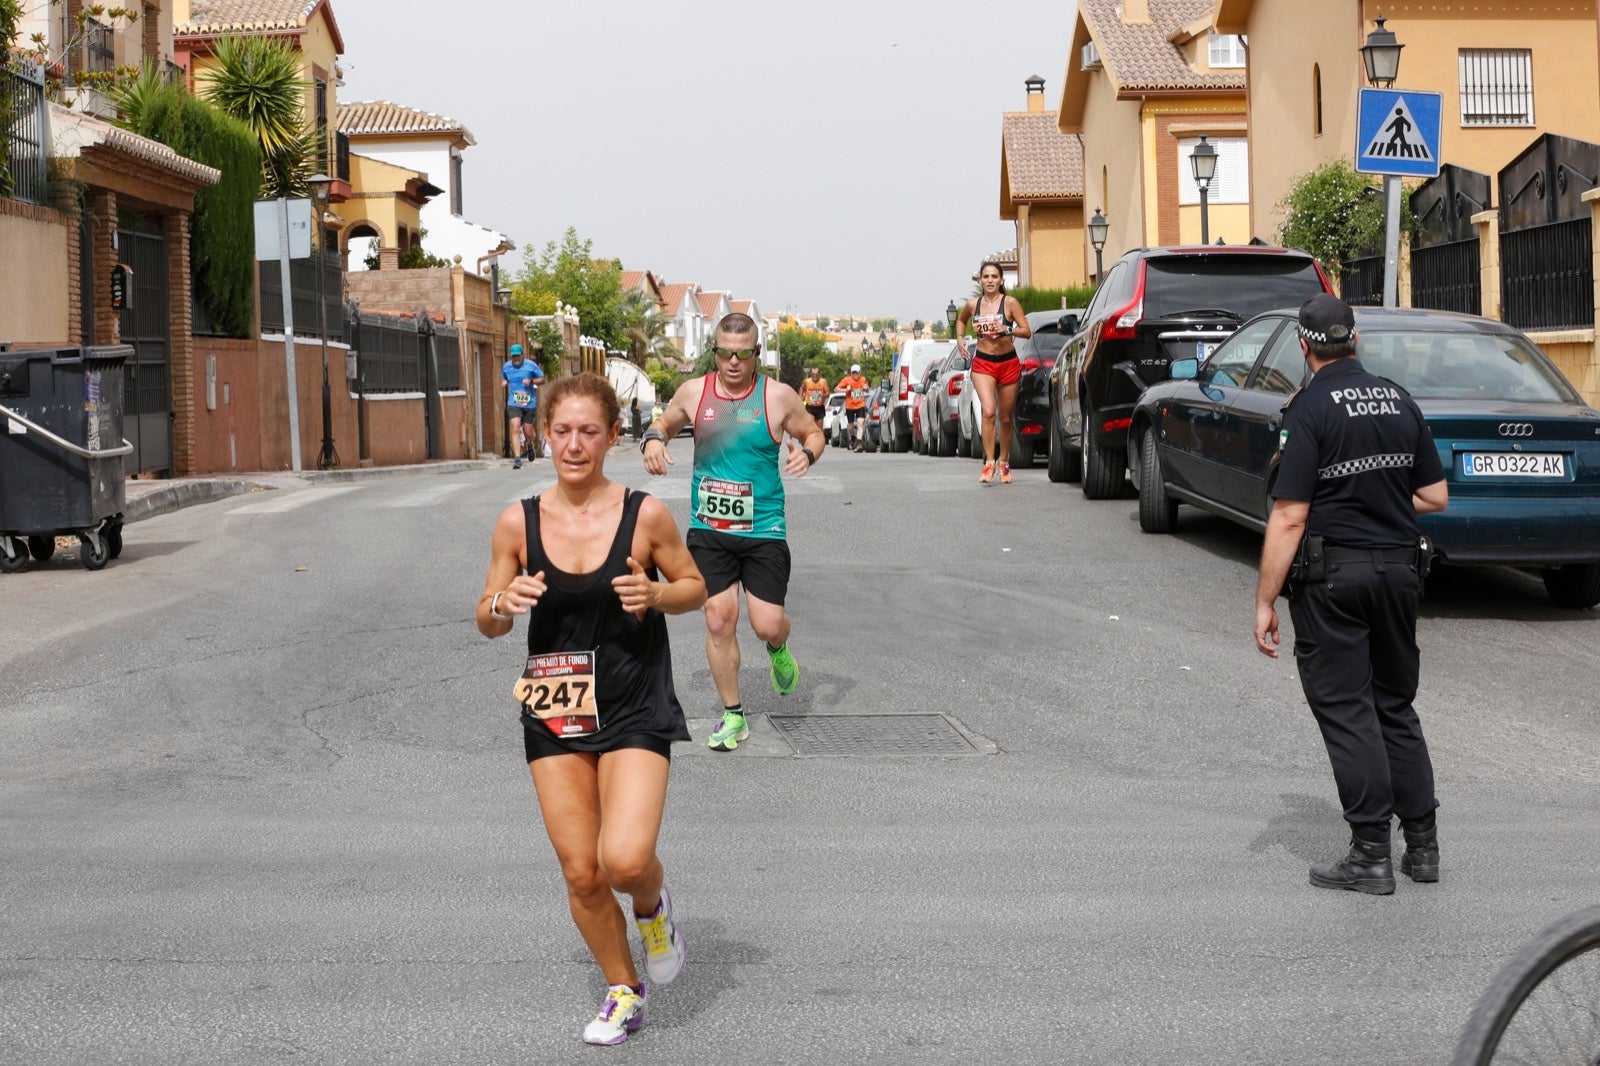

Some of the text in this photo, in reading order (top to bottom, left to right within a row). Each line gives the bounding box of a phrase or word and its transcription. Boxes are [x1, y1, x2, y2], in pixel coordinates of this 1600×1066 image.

[1330, 387, 1401, 404] POLICIA
[1345, 401, 1401, 417] LOCAL
[1473, 456, 1494, 472] GR
[1498, 456, 1539, 473] 0322
[1543, 457, 1562, 473] AK
[707, 496, 744, 517] 556
[537, 656, 558, 668] PREMIO
[559, 656, 567, 666] DE
[568, 655, 588, 666] FONDO
[522, 682, 589, 710] 2247
